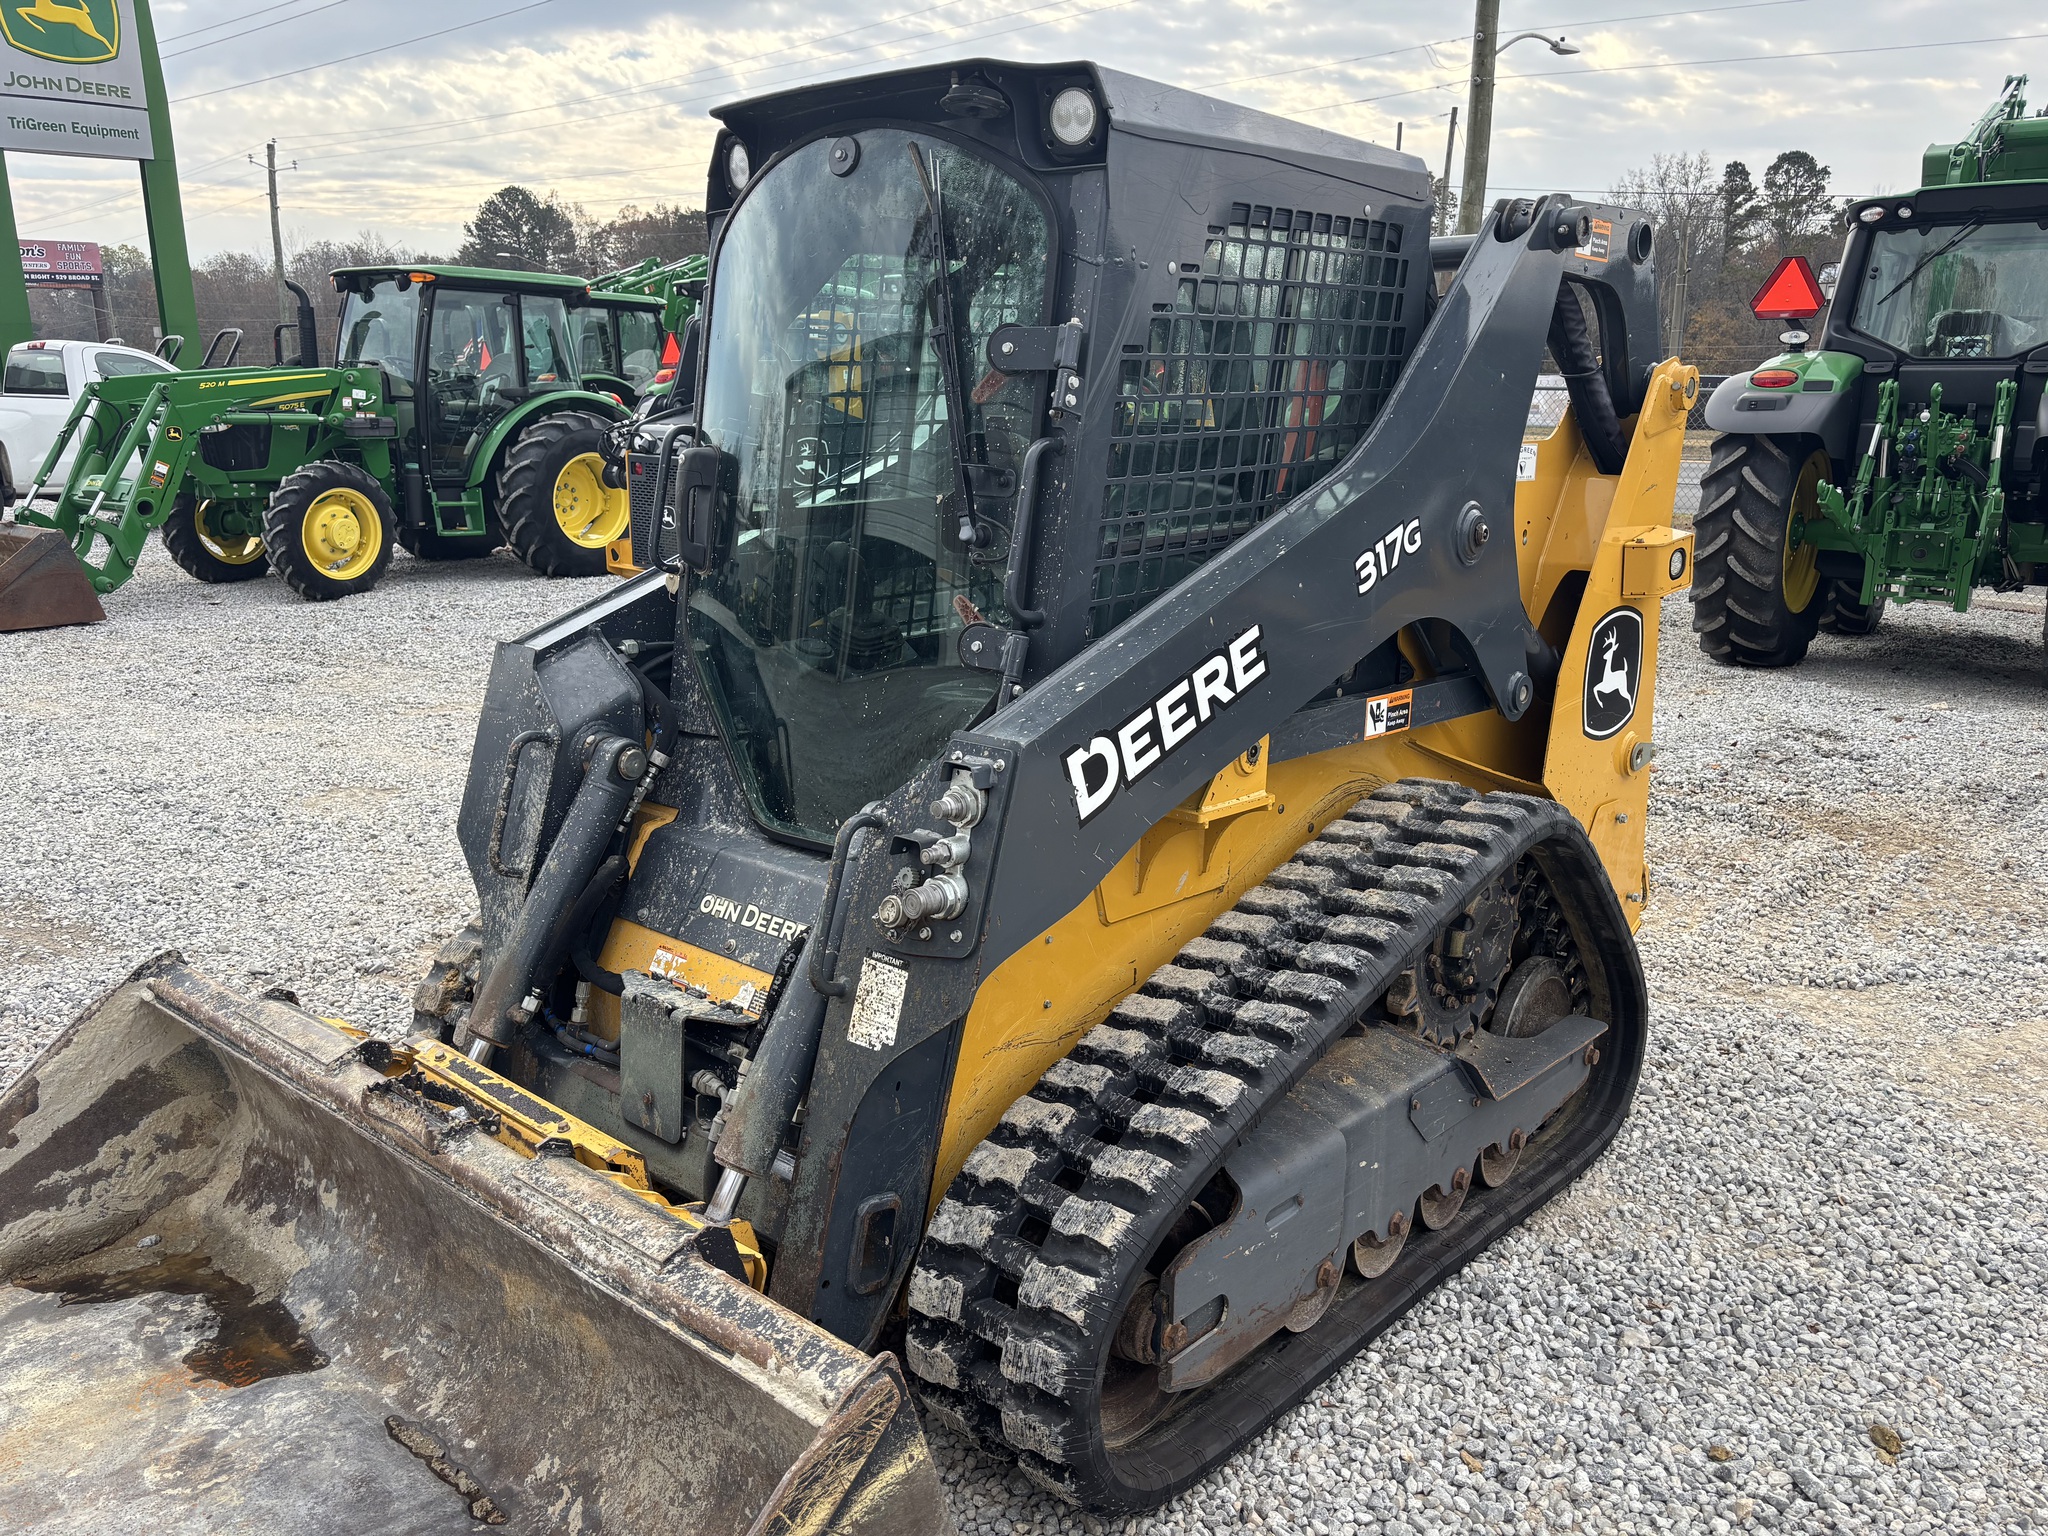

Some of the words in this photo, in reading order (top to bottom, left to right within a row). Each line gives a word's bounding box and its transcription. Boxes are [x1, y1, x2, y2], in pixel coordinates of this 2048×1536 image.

[4, 71, 63, 92] JOHN
[66, 76, 132, 99] DEERE
[7, 116, 67, 133] TriGreen
[71, 121, 140, 140] Equipment
[20, 246, 45, 257] on's
[57, 243, 86, 252] FAMILY
[1520, 446, 1536, 457] GREEN
[1355, 518, 1423, 595] 317G
[1066, 624, 1266, 821] DEERE
[700, 895, 742, 923] OHN
[872, 951, 904, 966] IMPORTANT
